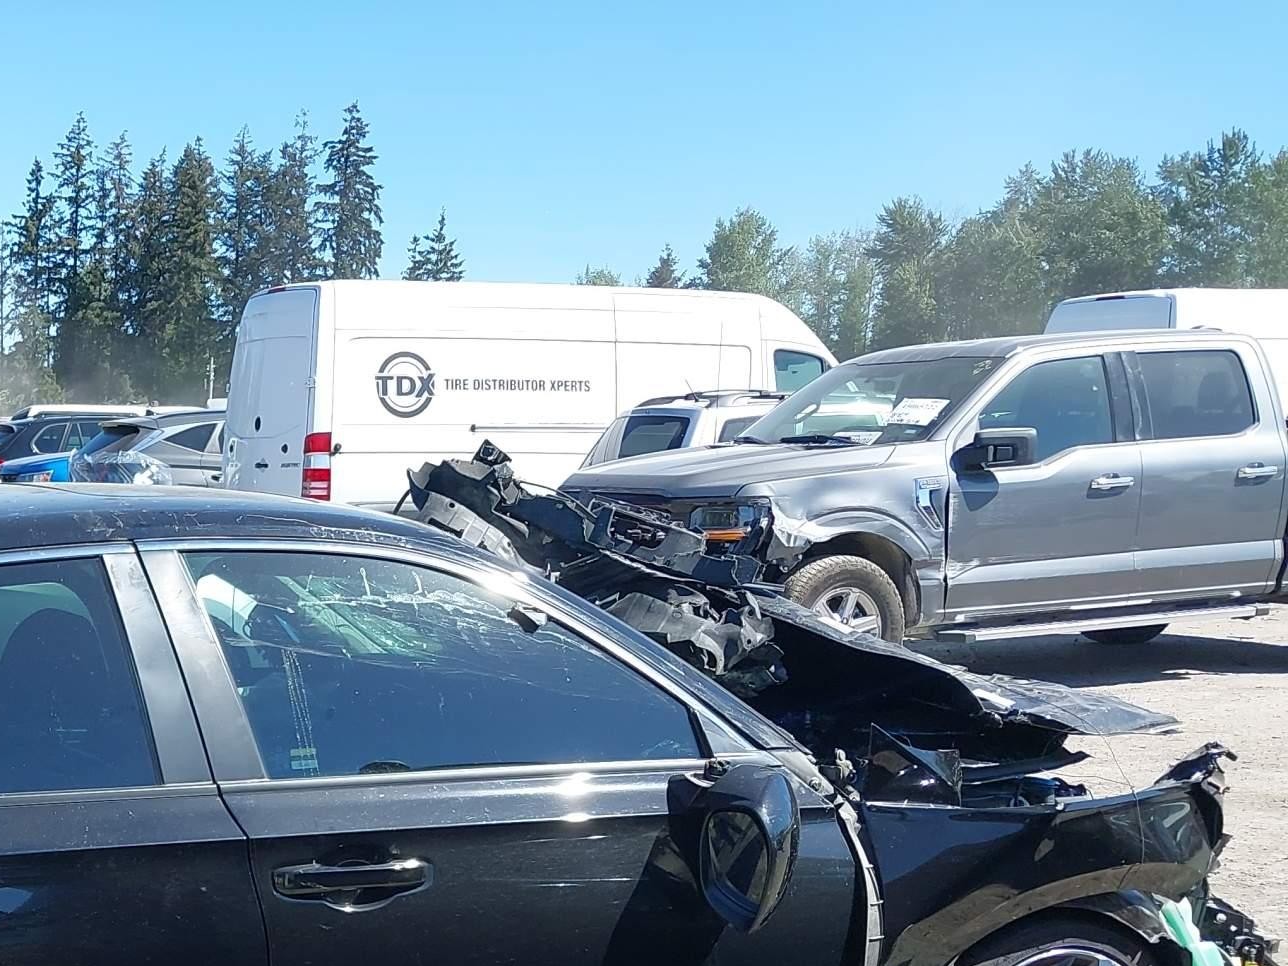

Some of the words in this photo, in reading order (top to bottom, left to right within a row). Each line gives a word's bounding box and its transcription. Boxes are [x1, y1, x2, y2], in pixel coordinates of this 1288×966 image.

[375, 373, 436, 398] TDX
[444, 378, 469, 391] TIRE
[473, 378, 546, 392] DISTRIBUTOR
[550, 380, 591, 393] XPERTS
